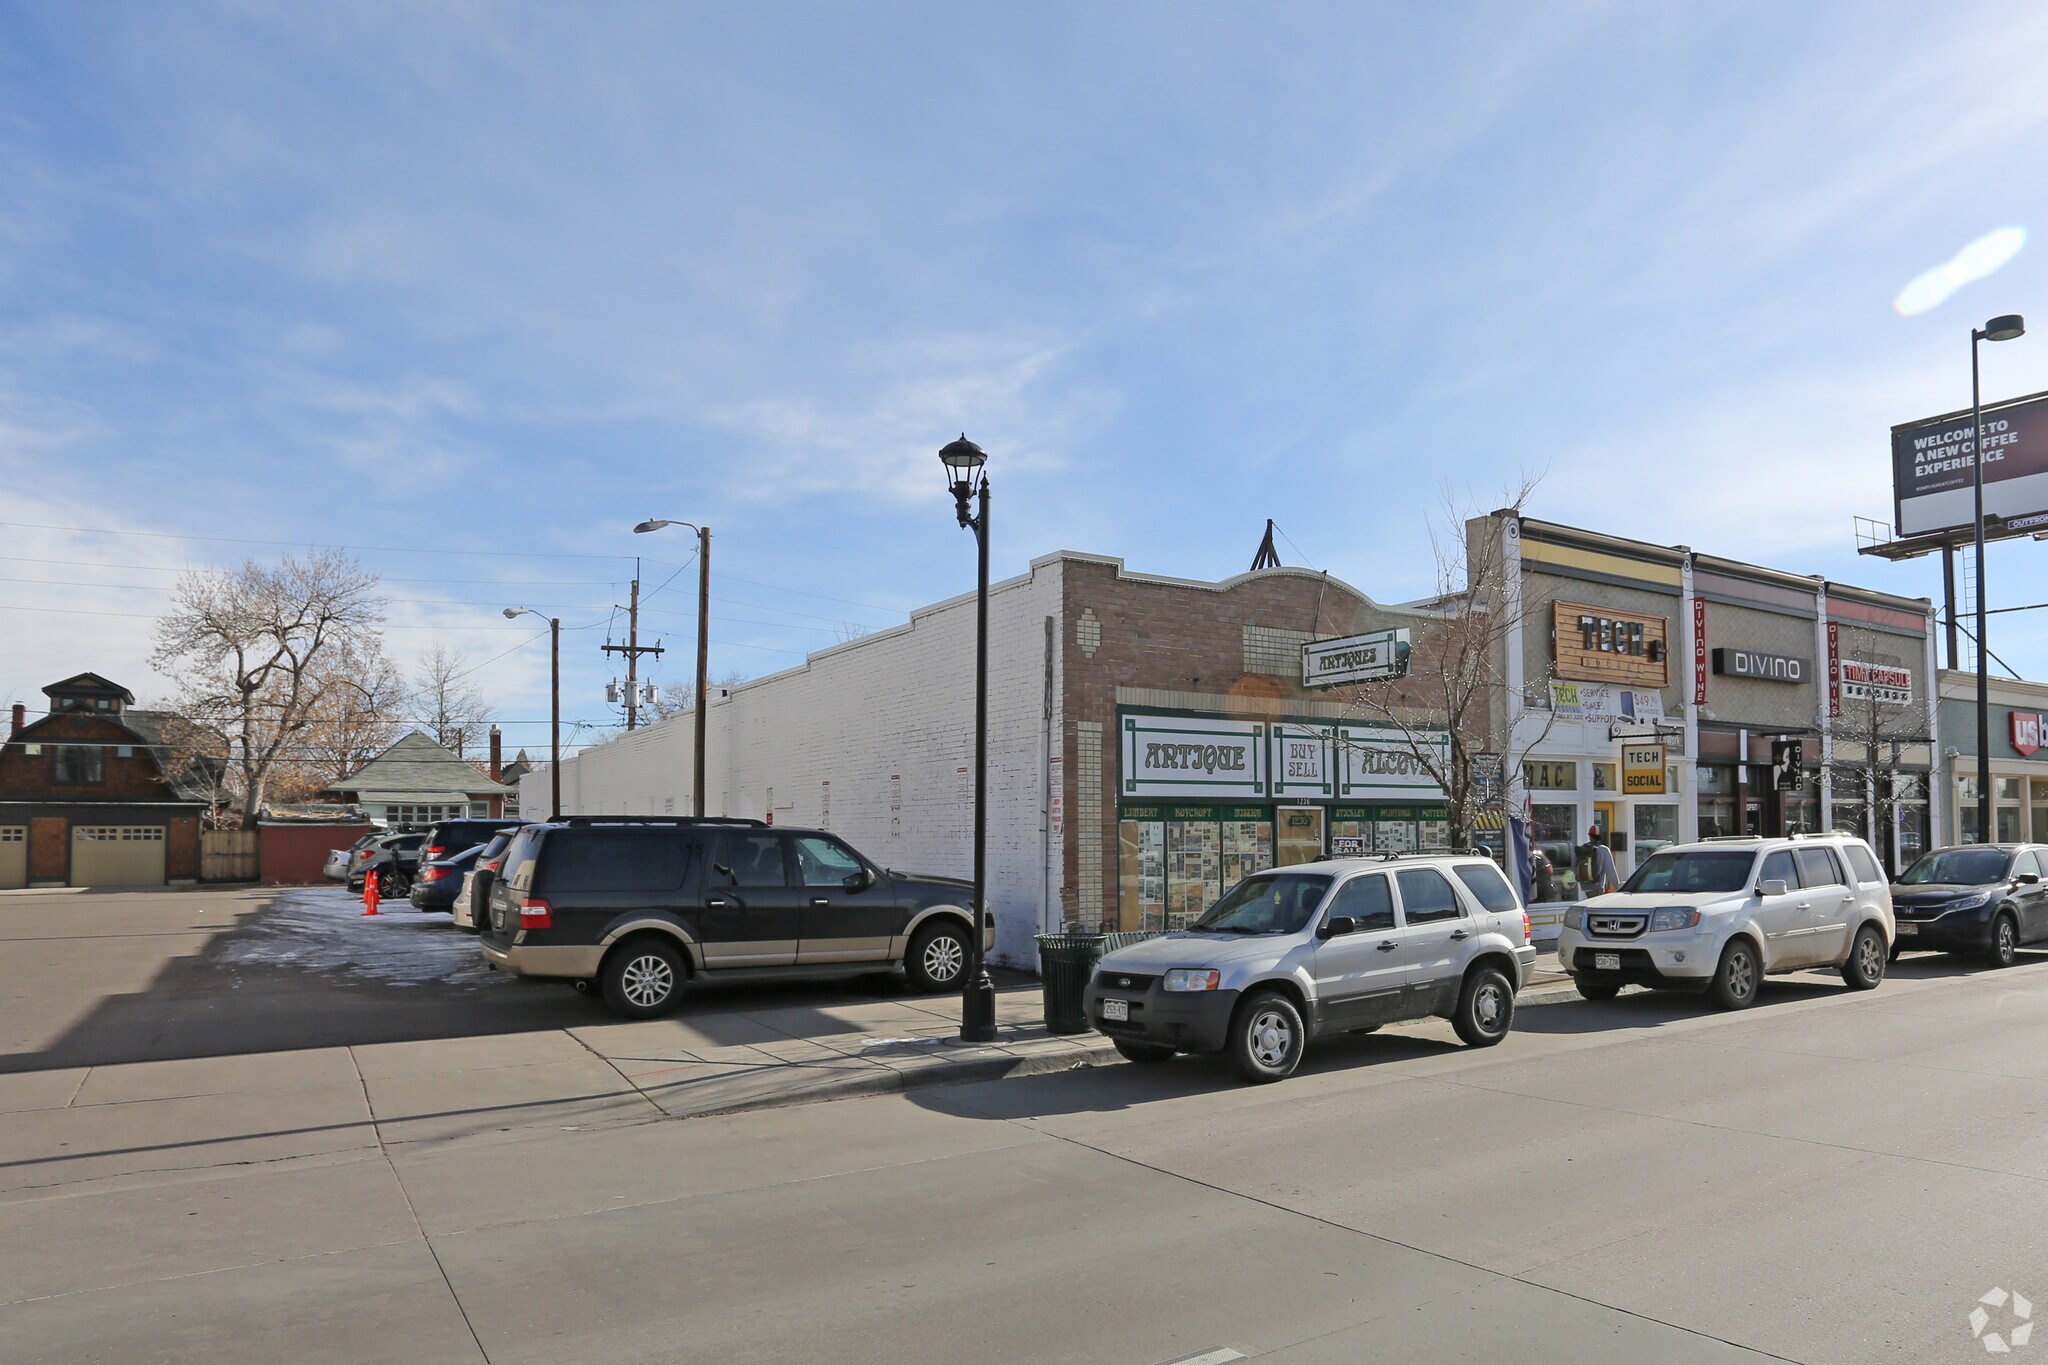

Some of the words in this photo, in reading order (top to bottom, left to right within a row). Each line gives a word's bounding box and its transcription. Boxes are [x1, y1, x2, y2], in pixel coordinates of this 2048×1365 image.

[1914, 424, 1986, 450] WELCOME
[1988, 420, 2009, 434] TO
[1915, 452, 1925, 464] A
[1927, 444, 1960, 461] NEW
[1577, 615, 1645, 656] TECH
[1695, 601, 1704, 657] DIVINO
[1319, 647, 1377, 671] ANTIQUES
[1829, 625, 1838, 674] DIVINO
[1735, 652, 1800, 679] DIVINO
[1846, 665, 1872, 683] TIM
[1872, 669, 1911, 688] CAPSULE
[1582, 688, 1610, 698] SERVICE
[1696, 663, 1705, 701] WINE
[1553, 685, 1578, 704] TECH
[1585, 701, 1606, 710] SALES
[1587, 713, 1617, 723] SUPPORT
[1144, 742, 1246, 774] ANTIQUE
[1289, 743, 1317, 759] BUY
[1629, 751, 1659, 764] TECH
[1288, 761, 1318, 778] SELL
[1522, 764, 1563, 788] MAC
[1794, 746, 1803, 791] DIVINO
[1627, 775, 1662, 787] SOCIAL
[1338, 839, 1358, 848] FOR
